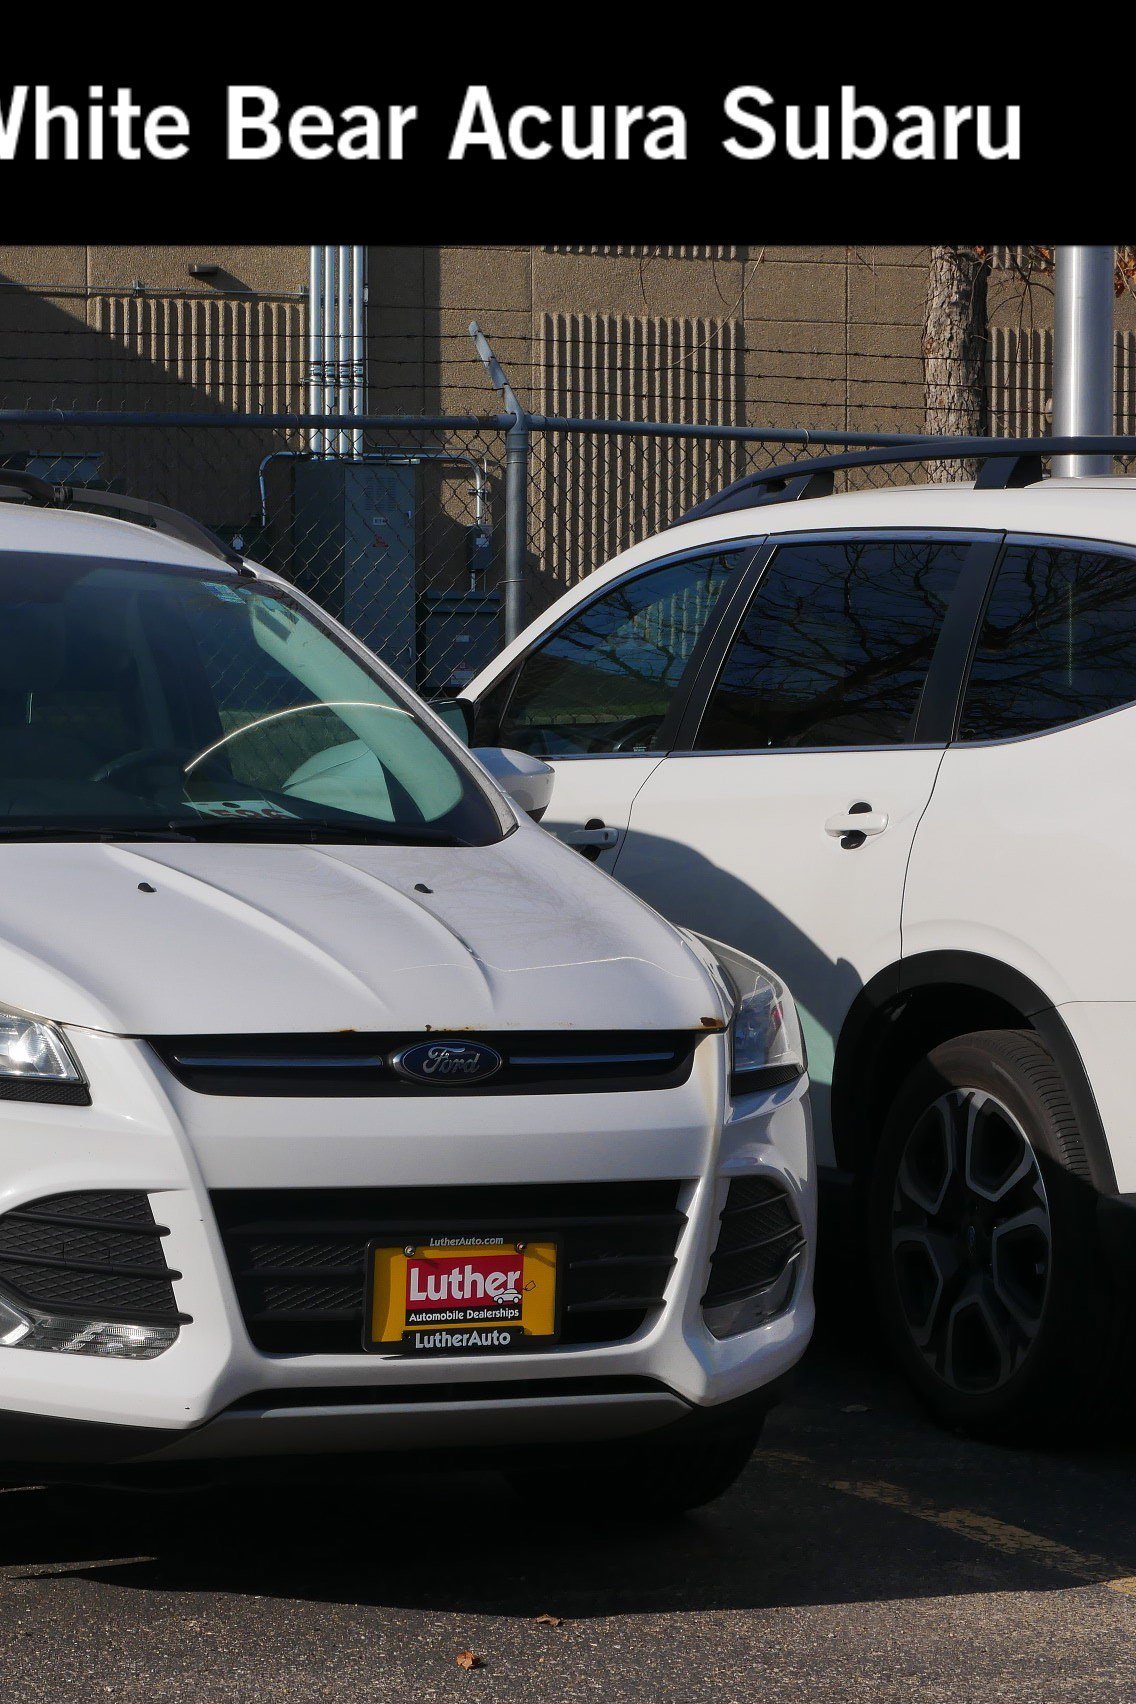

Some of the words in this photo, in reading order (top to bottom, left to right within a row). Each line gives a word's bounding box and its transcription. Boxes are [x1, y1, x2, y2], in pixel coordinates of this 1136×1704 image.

[422, 1046, 481, 1074] Ford
[429, 1236, 504, 1247] LutherAuto.com
[409, 1264, 521, 1301] Luther
[409, 1310, 464, 1322] Automobile
[466, 1308, 520, 1320] Dealerships
[415, 1330, 511, 1349] LutherAuto
